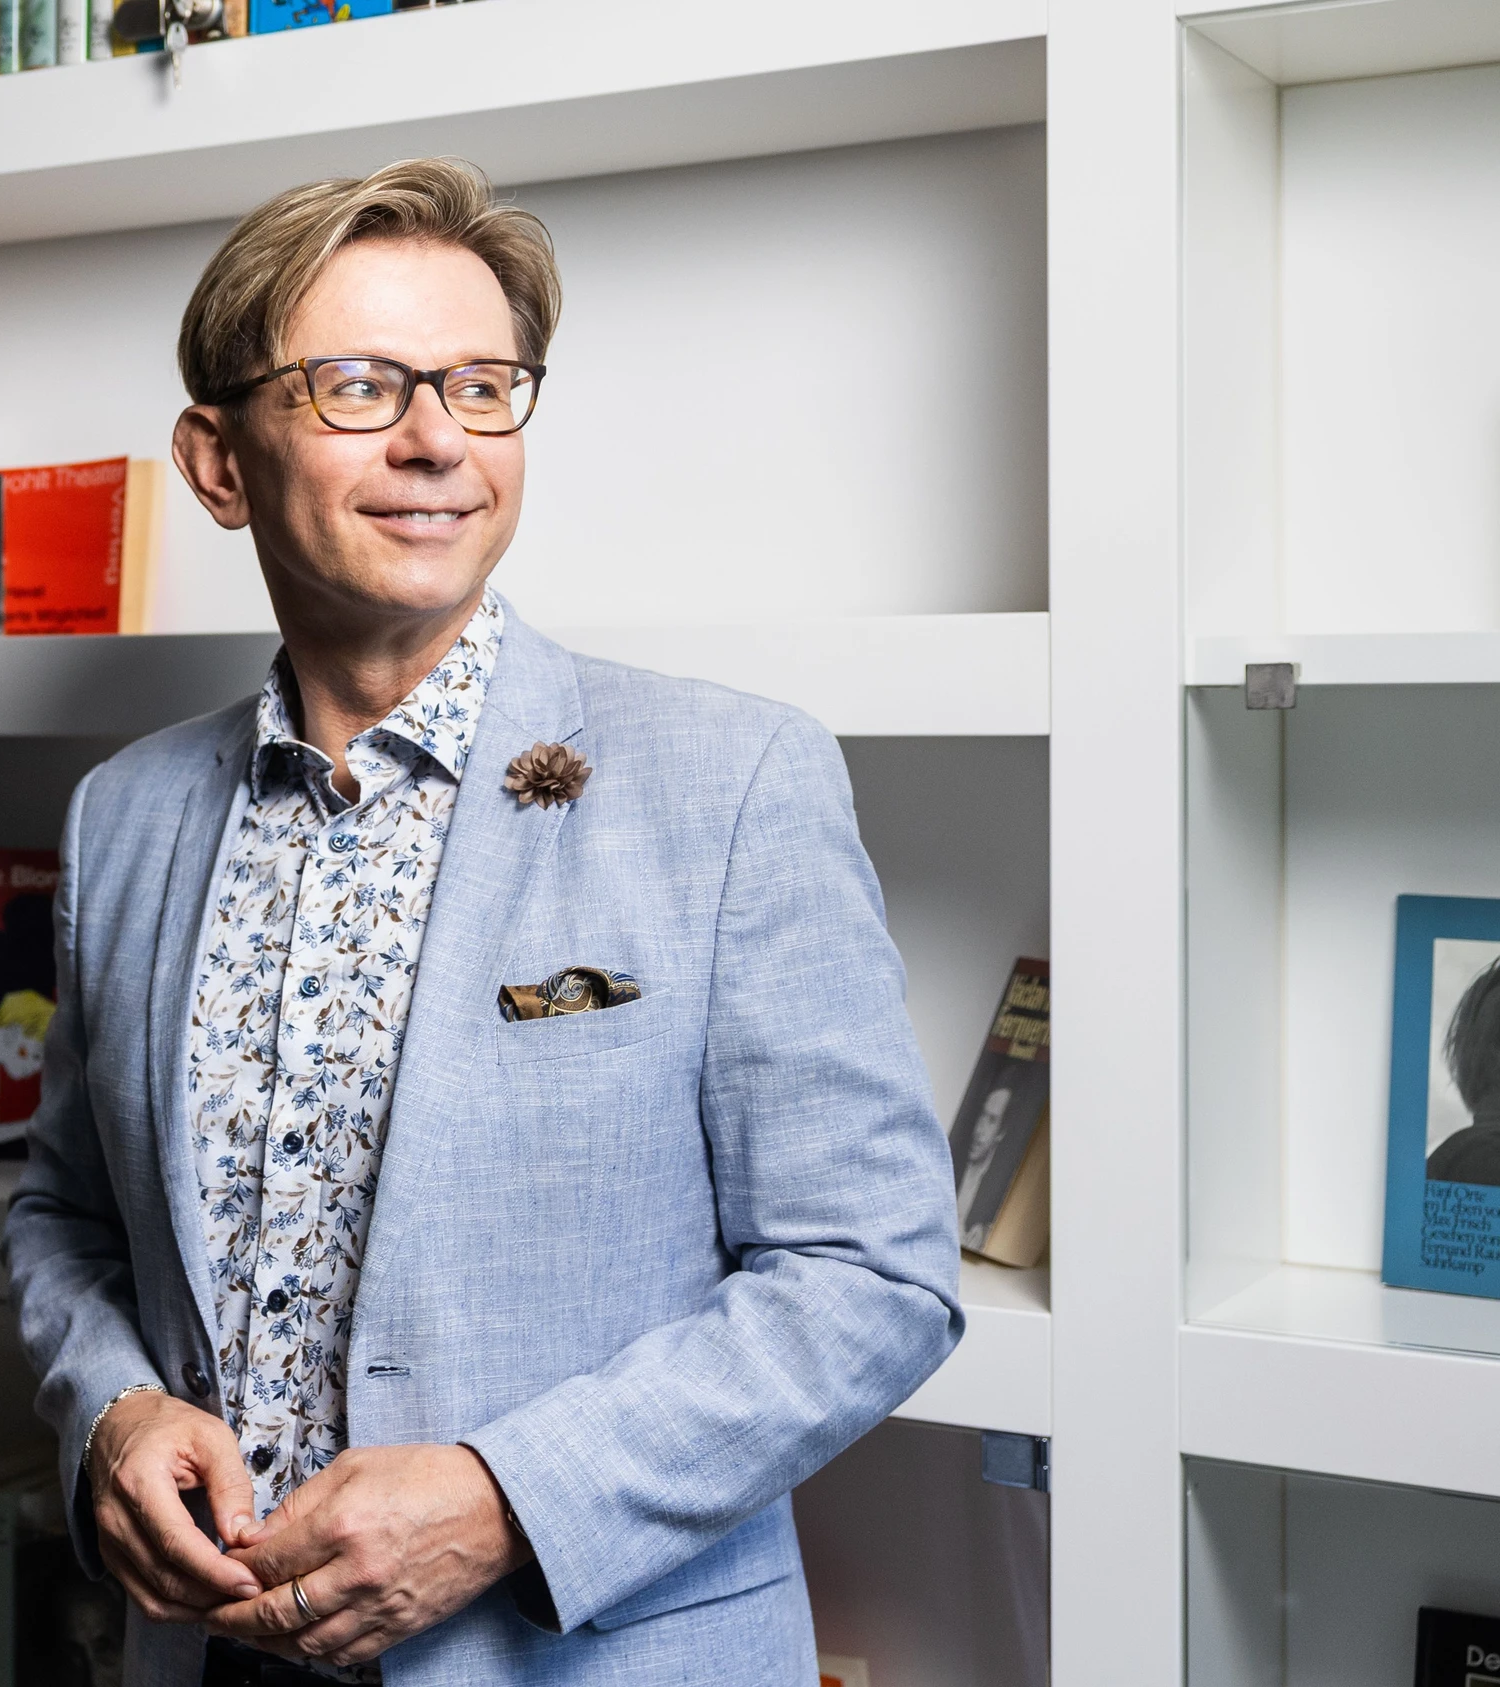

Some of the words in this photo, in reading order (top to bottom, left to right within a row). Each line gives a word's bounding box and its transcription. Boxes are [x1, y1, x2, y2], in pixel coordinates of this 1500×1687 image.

[54, 463, 126, 490] Theater
[1424, 1182, 1453, 1200] Fünf
[1454, 1186, 1487, 1203] Orte
[1442, 1197, 1482, 1217] Leben
[1423, 1209, 1453, 1227] Max
[1453, 1212, 1492, 1232] Frisch
[1421, 1223, 1476, 1243] Gesehen
[1420, 1253, 1486, 1278] Suhrkamp
[1466, 1644, 1500, 1672] De
